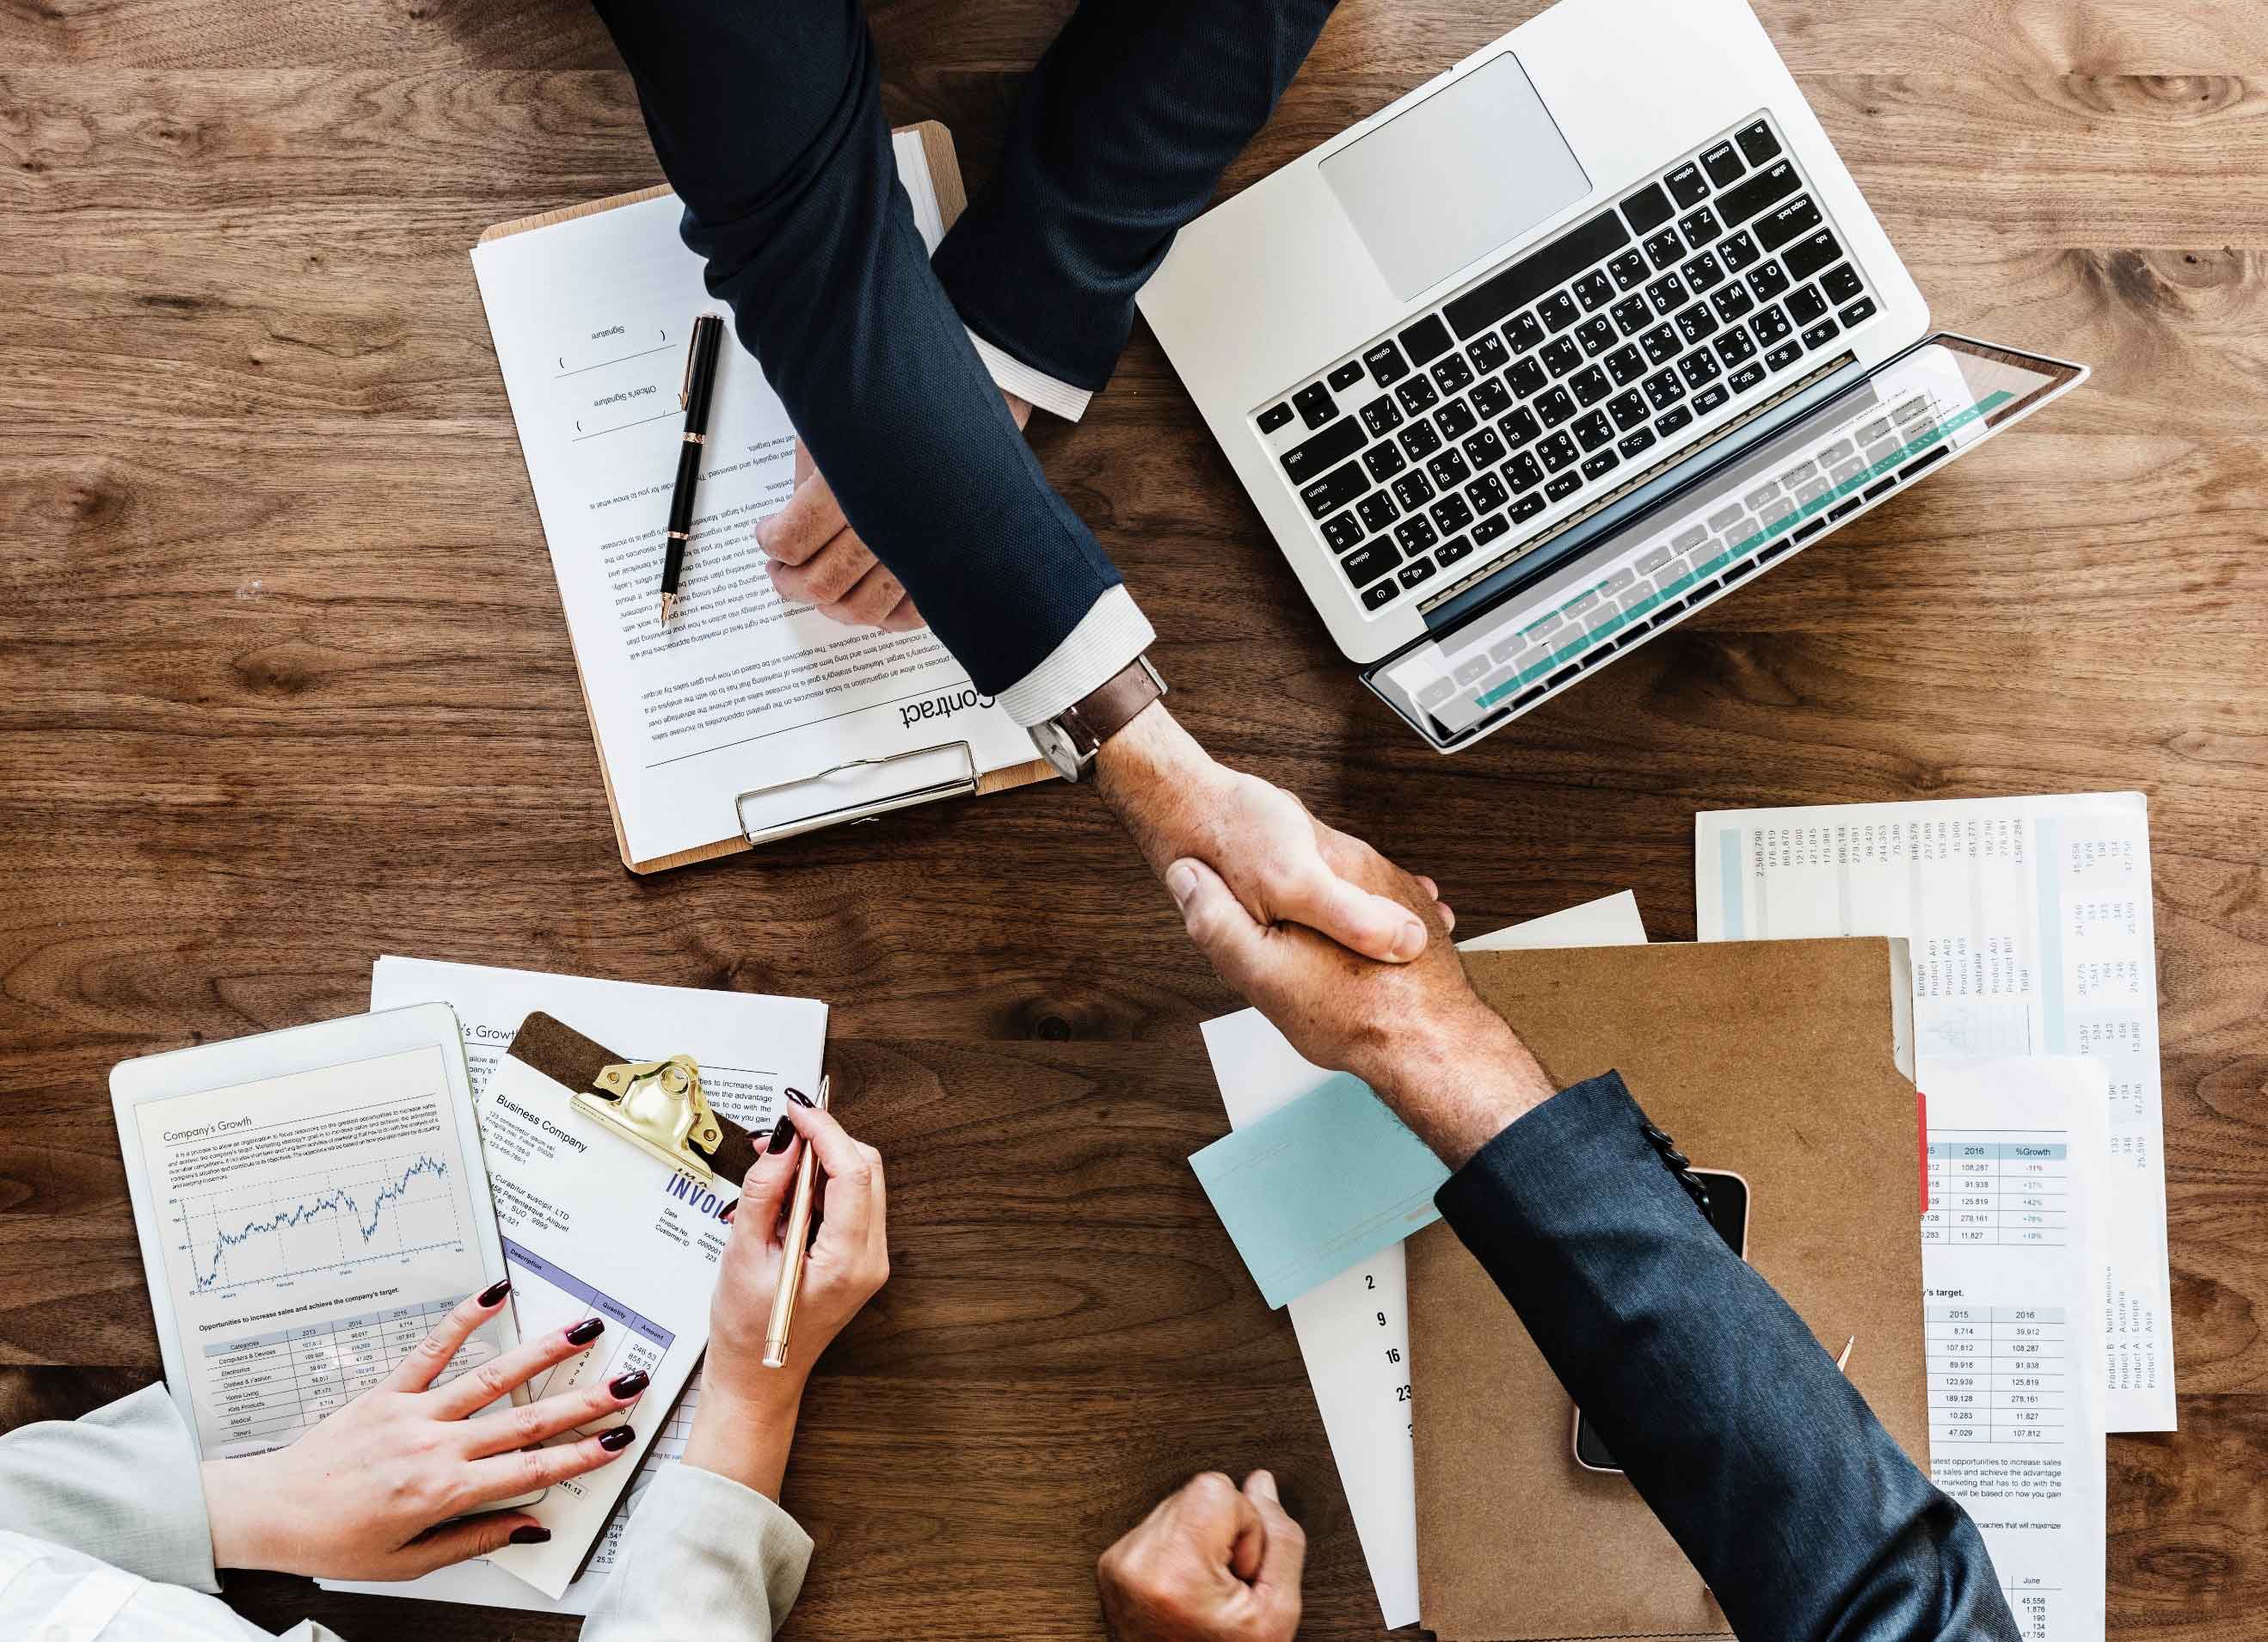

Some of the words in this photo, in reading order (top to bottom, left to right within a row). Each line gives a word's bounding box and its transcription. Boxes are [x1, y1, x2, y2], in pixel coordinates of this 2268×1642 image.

[1707, 145, 1730, 163] control
[1673, 167, 1694, 181] option
[1771, 163, 1786, 177] shift
[1790, 199, 1807, 212] caps
[1776, 208, 1792, 220] lock
[1816, 234, 1828, 244] tab
[1766, 265, 1777, 276] Q
[1730, 286, 1742, 299] W
[1698, 306, 1707, 317] E
[1852, 306, 1865, 317] esc
[591, 325, 625, 340] Signature
[1661, 327, 1672, 338] R
[1369, 347, 1391, 362] option
[1627, 349, 1637, 360] T
[1592, 370, 1601, 381] Y
[628, 384, 656, 397] Officer's
[593, 393, 627, 407] Signature
[1288, 452, 1303, 464] shift
[1308, 483, 1328, 497] return
[1318, 501, 1331, 512] enter
[1349, 551, 1370, 566] delete
[924, 655, 950, 667] process
[900, 665, 916, 674] allow
[851, 673, 889, 687] organization
[793, 690, 824, 703] resources
[825, 685, 843, 694] focus
[746, 703, 771, 716] greatest
[704, 710, 745, 727] opportunities
[651, 732, 668, 741] sales
[669, 724, 696, 736] increase
[1917, 964, 1926, 997] Europe
[1929, 961, 1939, 996] Product
[2020, 969, 2030, 992] Total
[722, 1081, 753, 1090] increase
[754, 1084, 773, 1092] sales
[734, 1092, 772, 1104] advantage
[163, 1126, 216, 1141] Company's
[218, 1116, 252, 1131] Growth
[489, 1110, 500, 1120] 123
[499, 1117, 530, 1137] consectetur
[495, 1094, 540, 1125] Business
[542, 1120, 587, 1153] Company
[493, 1133, 531, 1157] 123-456-789-0
[2015, 1147, 2051, 1156] %Growth
[489, 1141, 526, 1164] 123-456-789-1
[495, 1174, 526, 1196] Curabitur
[526, 1193, 552, 1211] suscipit
[664, 1208, 678, 1219] Date
[532, 1217, 549, 1230] 9999
[545, 1216, 569, 1233] Aliquet
[659, 1216, 679, 1232] Invoice
[655, 1224, 682, 1243] Customer
[704, 1252, 717, 1264] 223
[1365, 1275, 1375, 1290] 2
[510, 1248, 542, 1270] Description
[602, 1302, 626, 1319] Quantity
[641, 1325, 664, 1341] Amount
[1936, 1289, 1964, 1298] target.
[199, 1319, 242, 1332] Opportunities
[249, 1312, 277, 1321] increase
[309, 1301, 333, 1310] achieve
[345, 1292, 378, 1303] company's
[378, 1287, 399, 1296] target.
[1377, 1312, 1386, 1326] 9
[1386, 1348, 1401, 1364] 16
